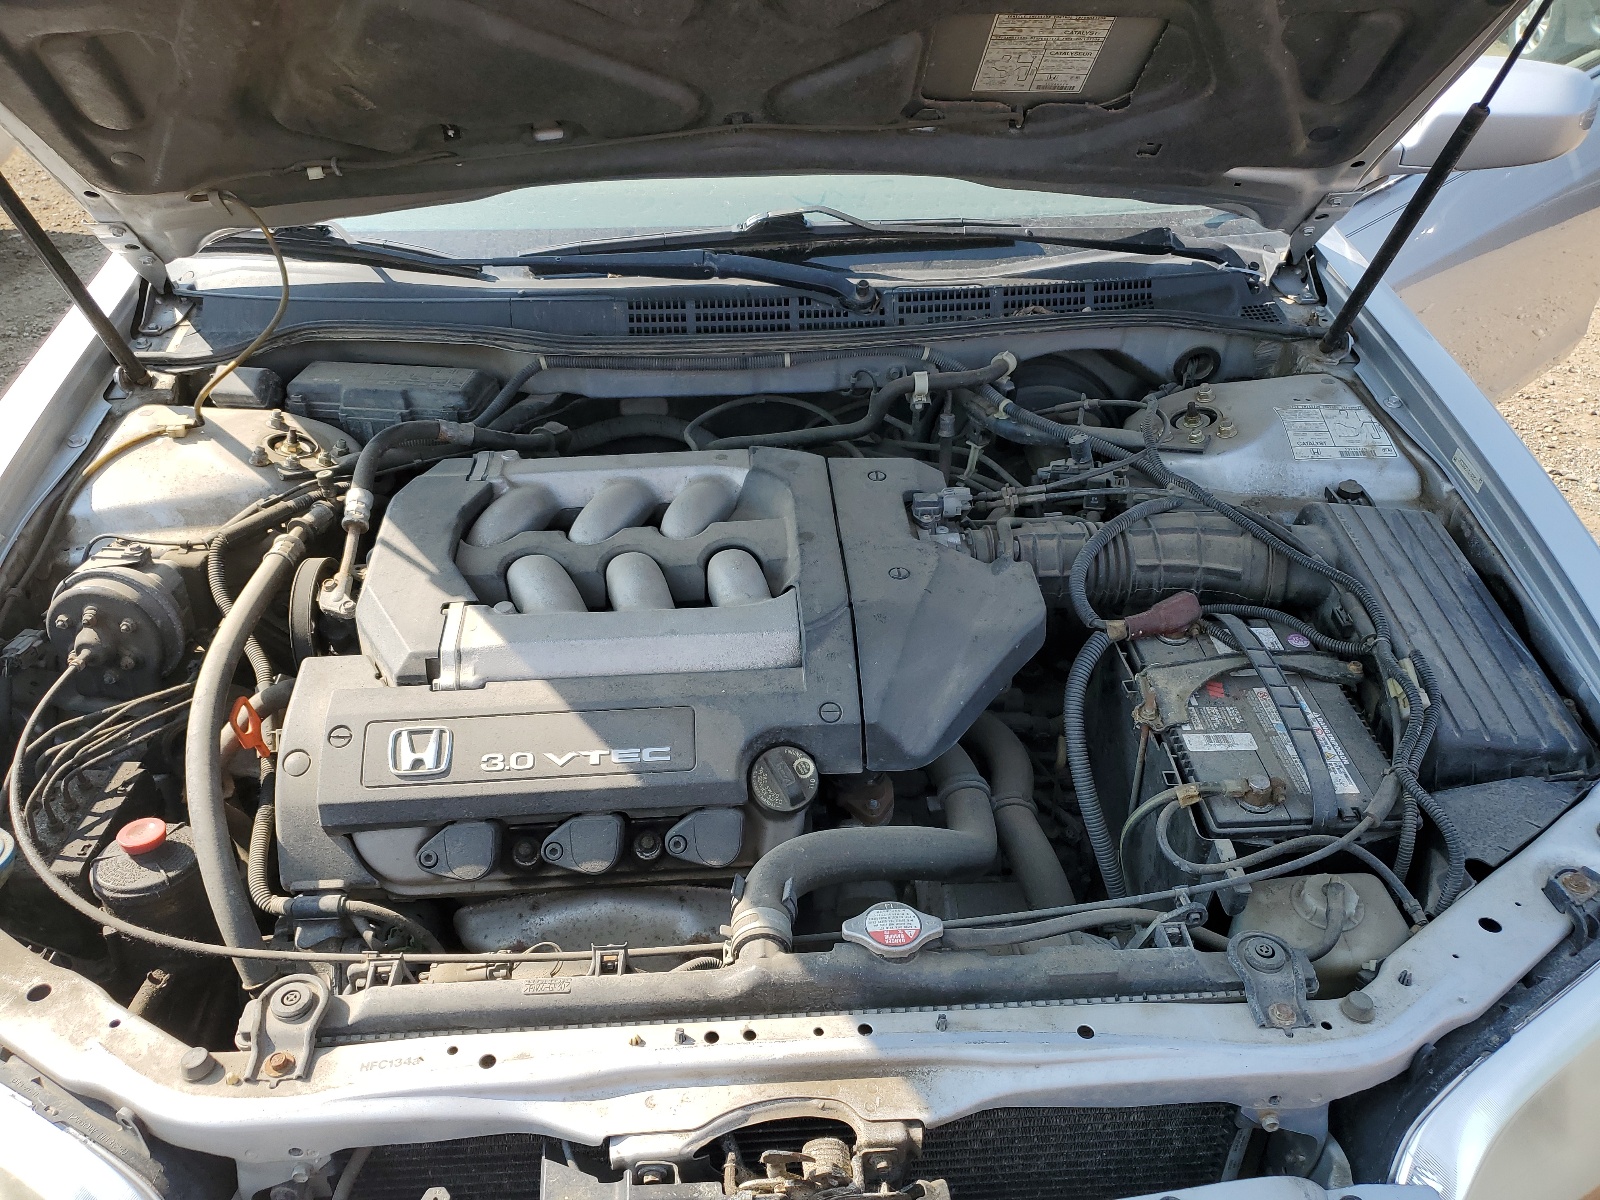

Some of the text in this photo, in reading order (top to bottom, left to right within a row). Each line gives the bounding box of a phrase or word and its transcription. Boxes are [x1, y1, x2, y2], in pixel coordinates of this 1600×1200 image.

[479, 746, 672, 772] 3.0 VTEC
[359, 1056, 421, 1072] HFC134a
